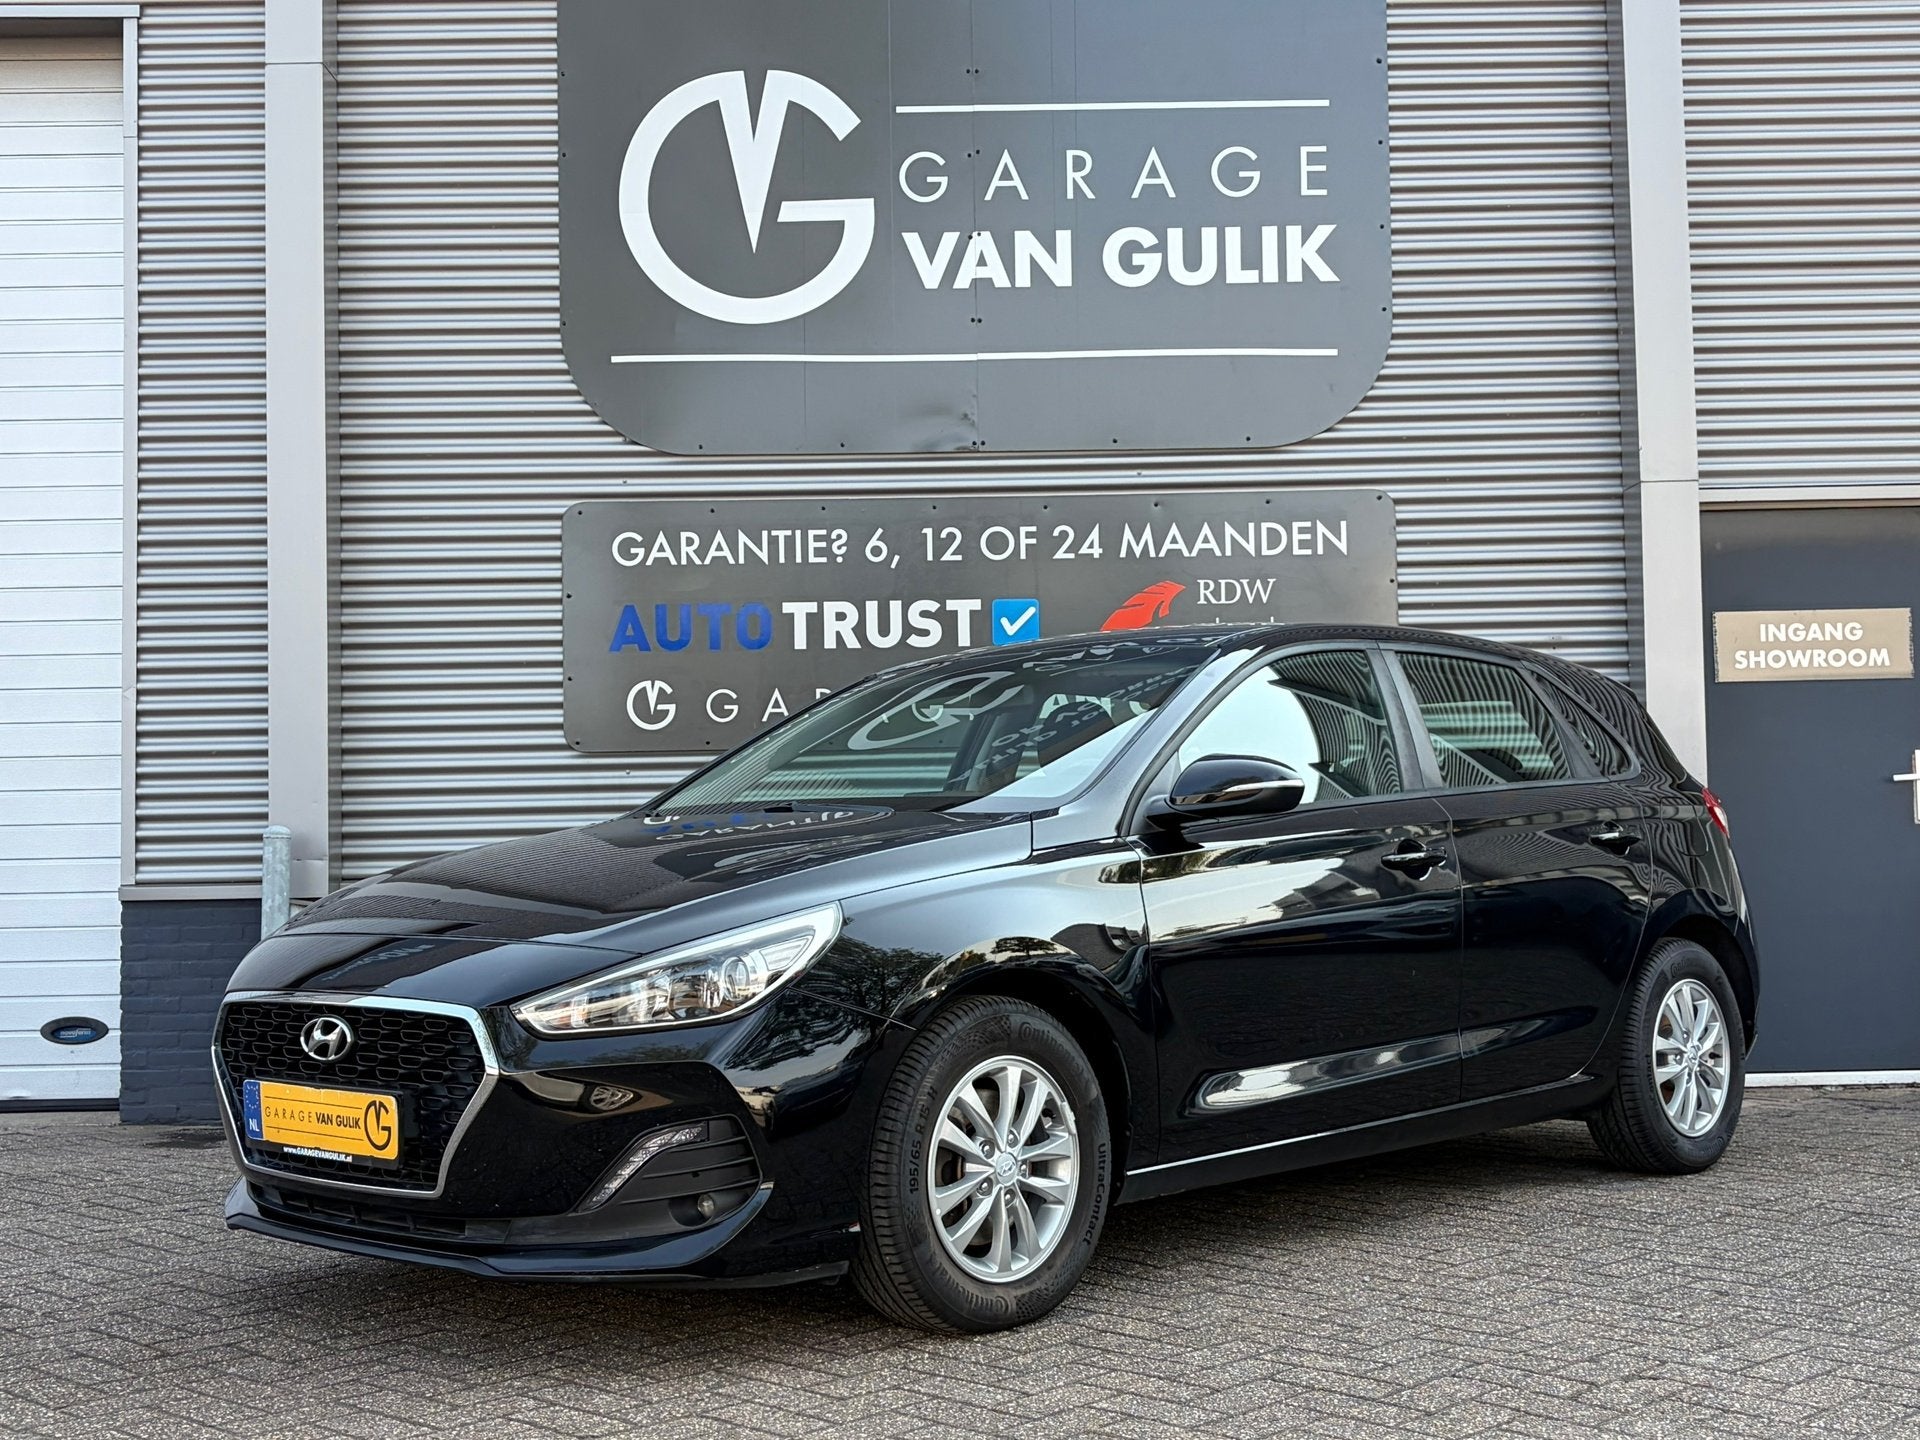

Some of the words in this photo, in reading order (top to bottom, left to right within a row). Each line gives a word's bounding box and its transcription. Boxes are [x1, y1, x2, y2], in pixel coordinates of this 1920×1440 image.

[898, 145, 1330, 203] GARAGE
[902, 229, 1073, 291] VAN
[1102, 224, 1341, 288] GULIK
[611, 528, 849, 568] GARANTIE?
[864, 527, 901, 569] 6,
[921, 526, 963, 562] 12
[979, 525, 1037, 561] OF
[1052, 523, 1103, 560] 24
[1119, 519, 1348, 559] MAANDEN
[1196, 578, 1276, 605] RDW
[1759, 621, 1864, 643] INGANG
[1734, 647, 1891, 670] SHOWROOM
[249, 1117, 260, 1132] NL
[264, 1106, 313, 1123] GARAGE
[315, 1111, 334, 1127] VAN
[335, 1113, 362, 1130] GULIK
[909, 1139, 922, 1195] 195/65
[1083, 1142, 1107, 1246] UltraContact
